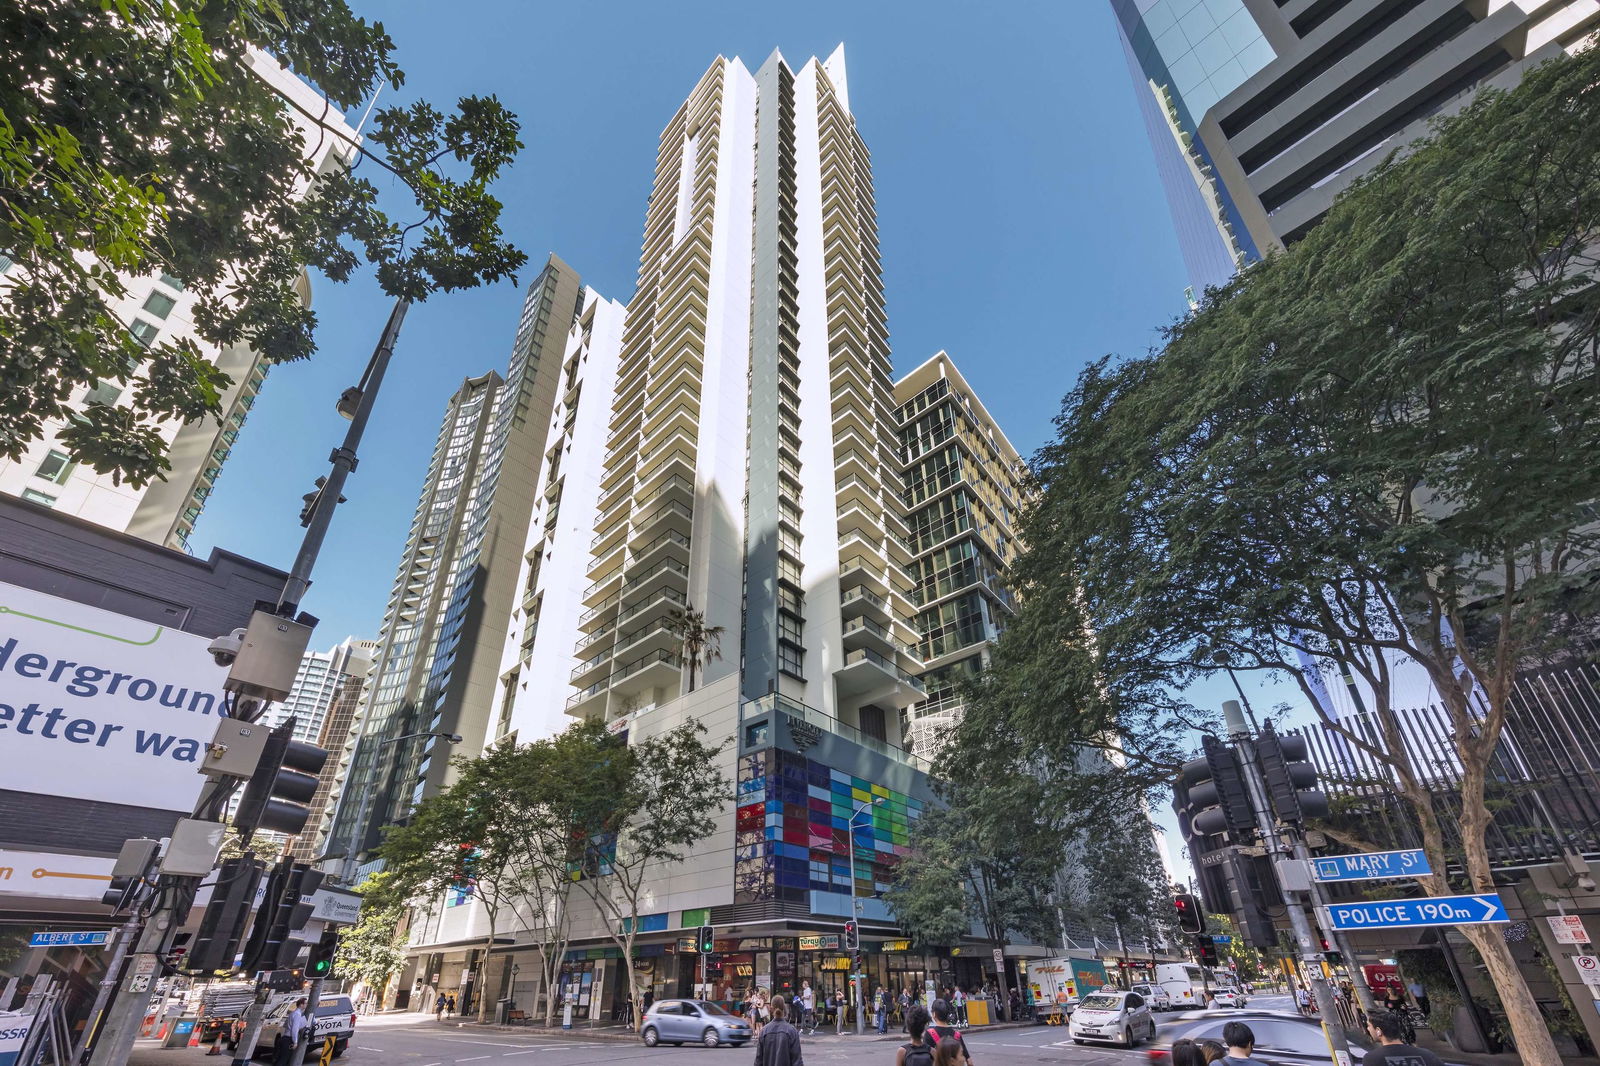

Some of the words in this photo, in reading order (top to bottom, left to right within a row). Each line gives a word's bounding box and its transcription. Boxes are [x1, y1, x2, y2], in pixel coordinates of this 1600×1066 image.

[135, 729, 212, 762] wa
[1202, 851, 1225, 865] hotel
[1344, 854, 1390, 872] MARY
[1401, 852, 1418, 868] ST
[1367, 869, 1379, 877] 89
[336, 902, 359, 911] Queensland
[1338, 905, 1411, 925] POLICE
[1416, 903, 1472, 921] 190m
[35, 933, 75, 942] ALBERT
[79, 933, 89, 941] ST
[882, 941, 911, 951] SUBWAY
[821, 957, 852, 970] SUBWAY
[314, 1021, 343, 1031] OYOTA
[0, 1028, 27, 1039] SSR
